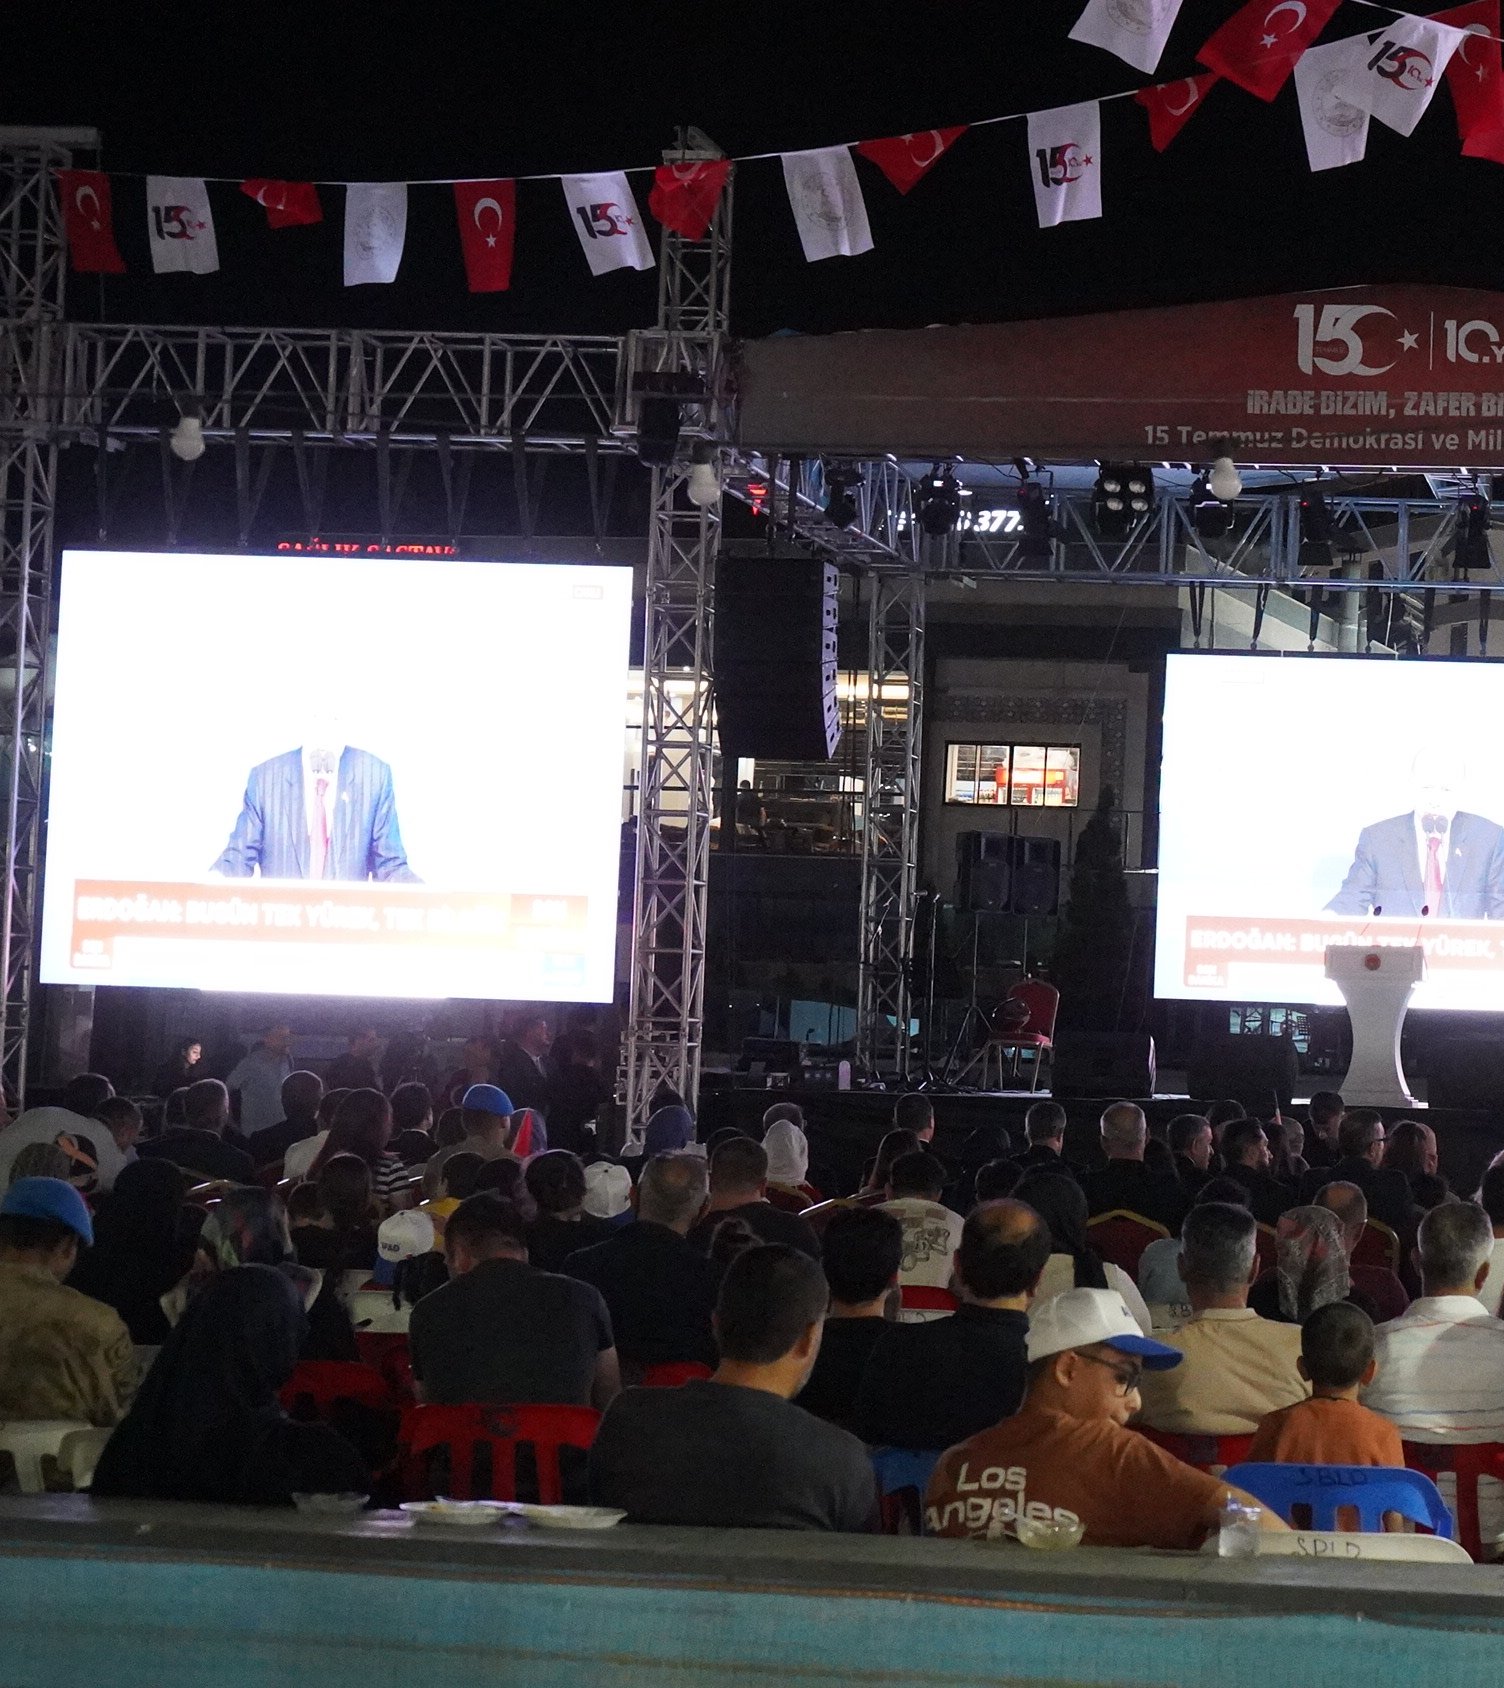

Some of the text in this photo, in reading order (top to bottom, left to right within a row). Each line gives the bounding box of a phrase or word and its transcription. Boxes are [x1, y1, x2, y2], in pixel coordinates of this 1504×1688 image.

[1293, 304, 1366, 376] 15
[1247, 389, 1314, 415] İRADE
[1321, 390, 1395, 419] BİZİM,
[1403, 392, 1476, 417] ZAFER
[1144, 425, 1169, 446] 15
[1431, 434, 1459, 450] ve
